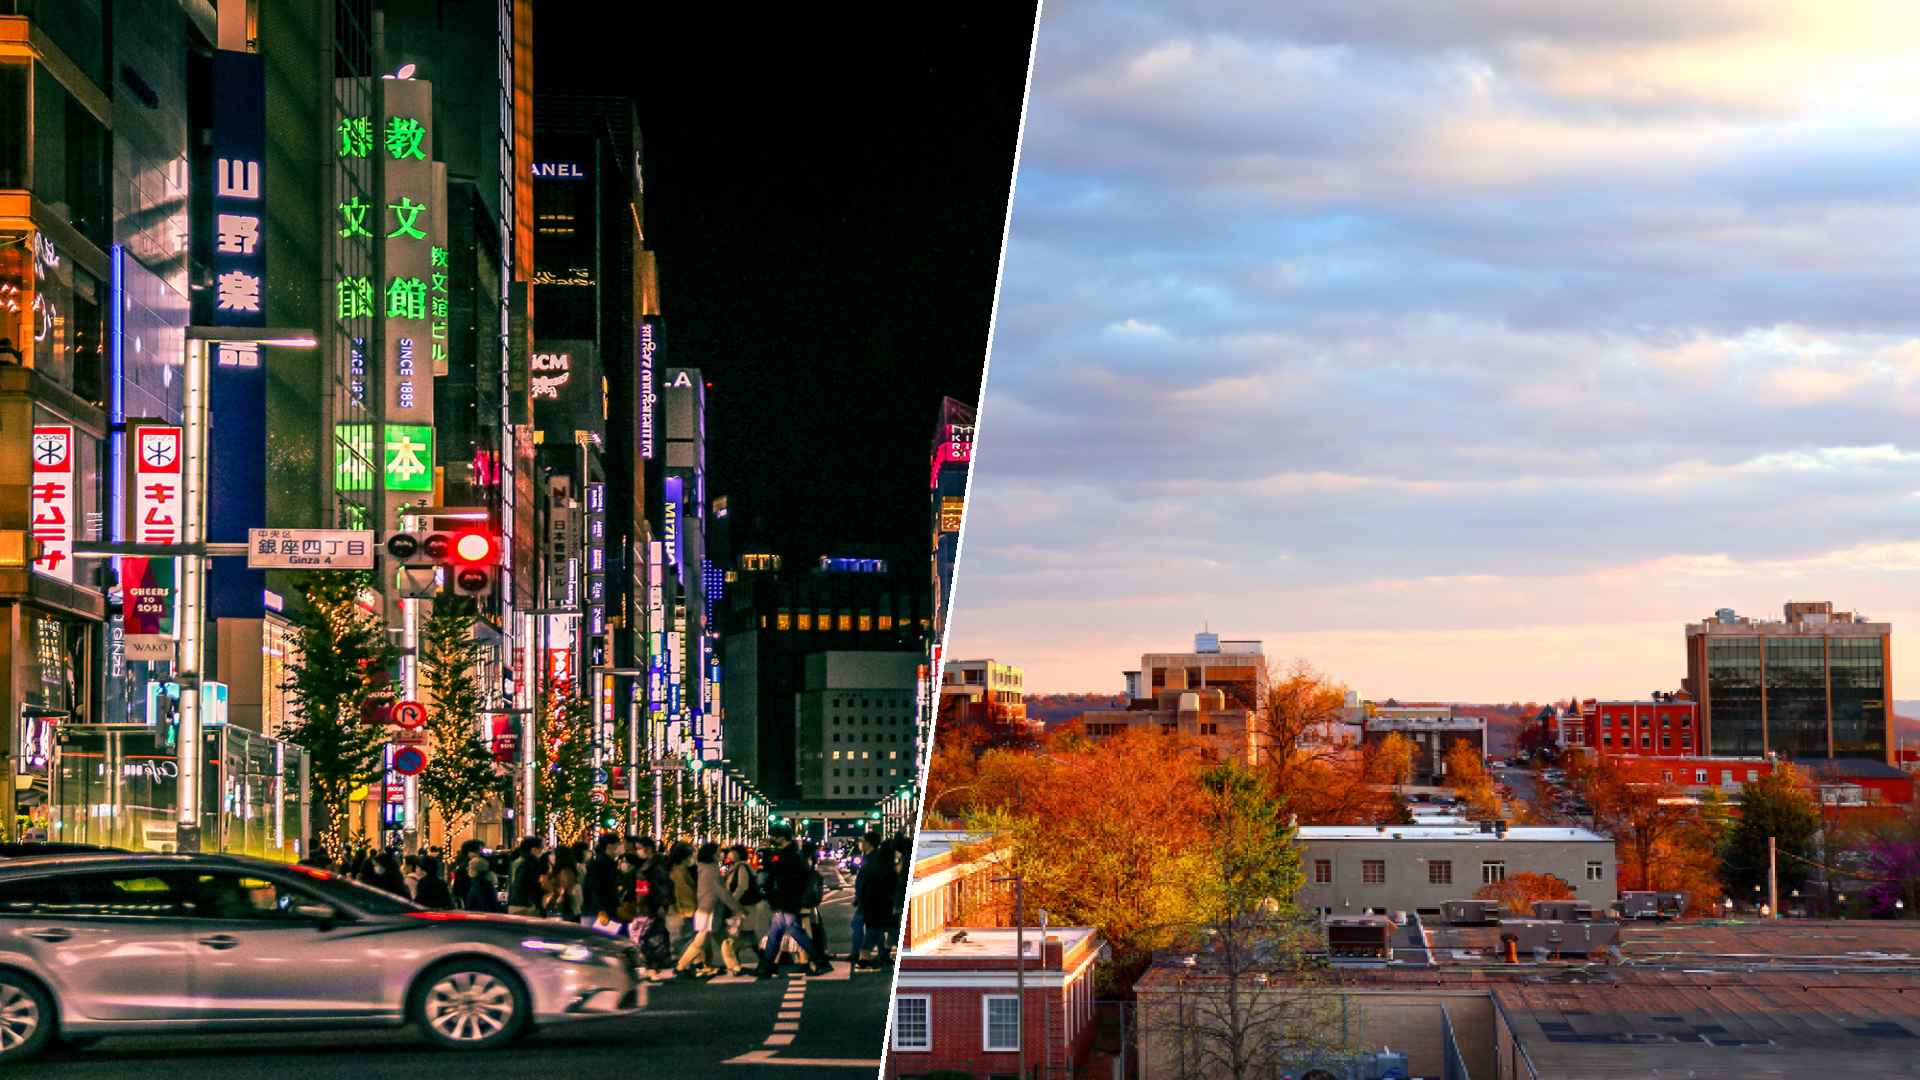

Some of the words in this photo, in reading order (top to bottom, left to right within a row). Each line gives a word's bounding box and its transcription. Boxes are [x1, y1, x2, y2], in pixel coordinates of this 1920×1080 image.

[385, 115, 428, 320] 教文館
[431, 245, 449, 361] 教文館ビル
[400, 338, 413, 376] SINCE
[400, 381, 413, 408] 1885
[387, 436, 426, 480] 本
[258, 530, 292, 538] 中央区
[258, 539, 365, 556] 銀座四丁目
[289, 556, 320, 565] Ginza
[324, 556, 332, 565] 4
[130, 587, 169, 596] CHEERS
[137, 604, 163, 613] 2021
[133, 643, 168, 653] WAKO
